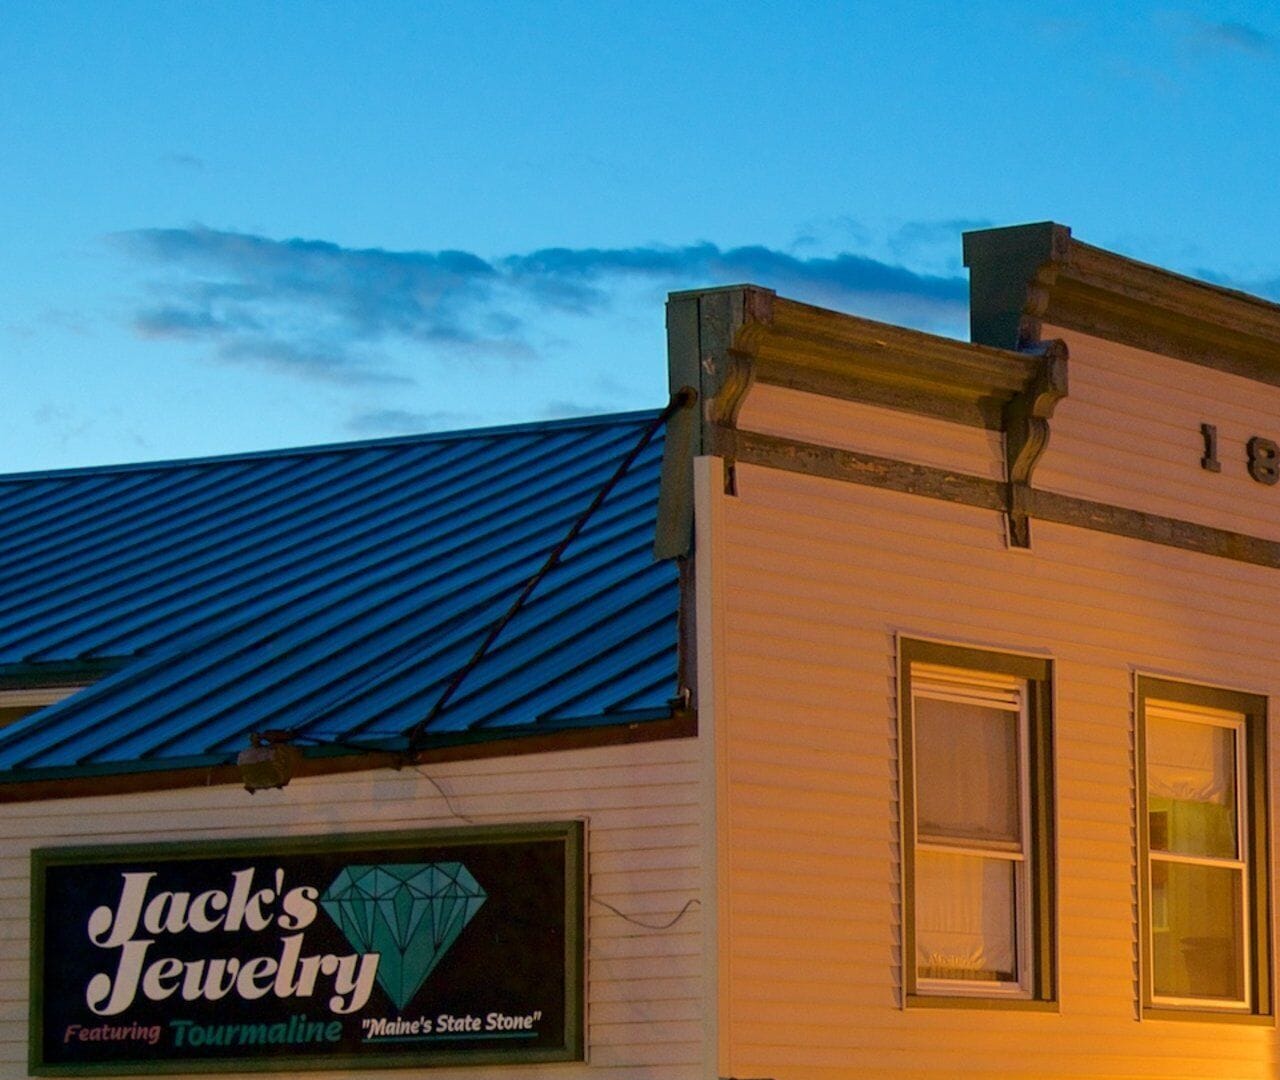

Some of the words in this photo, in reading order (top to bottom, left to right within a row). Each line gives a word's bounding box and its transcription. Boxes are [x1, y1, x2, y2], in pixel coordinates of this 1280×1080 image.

[87, 866, 320, 949] Jack's
[86, 932, 380, 1016] Jewelry
[63, 1021, 162, 1044] Featuring
[169, 1014, 344, 1047] Tourmaline
[361, 1014, 432, 1039] "Maine's
[436, 1013, 482, 1034] State
[485, 1010, 542, 1031] Stone"
